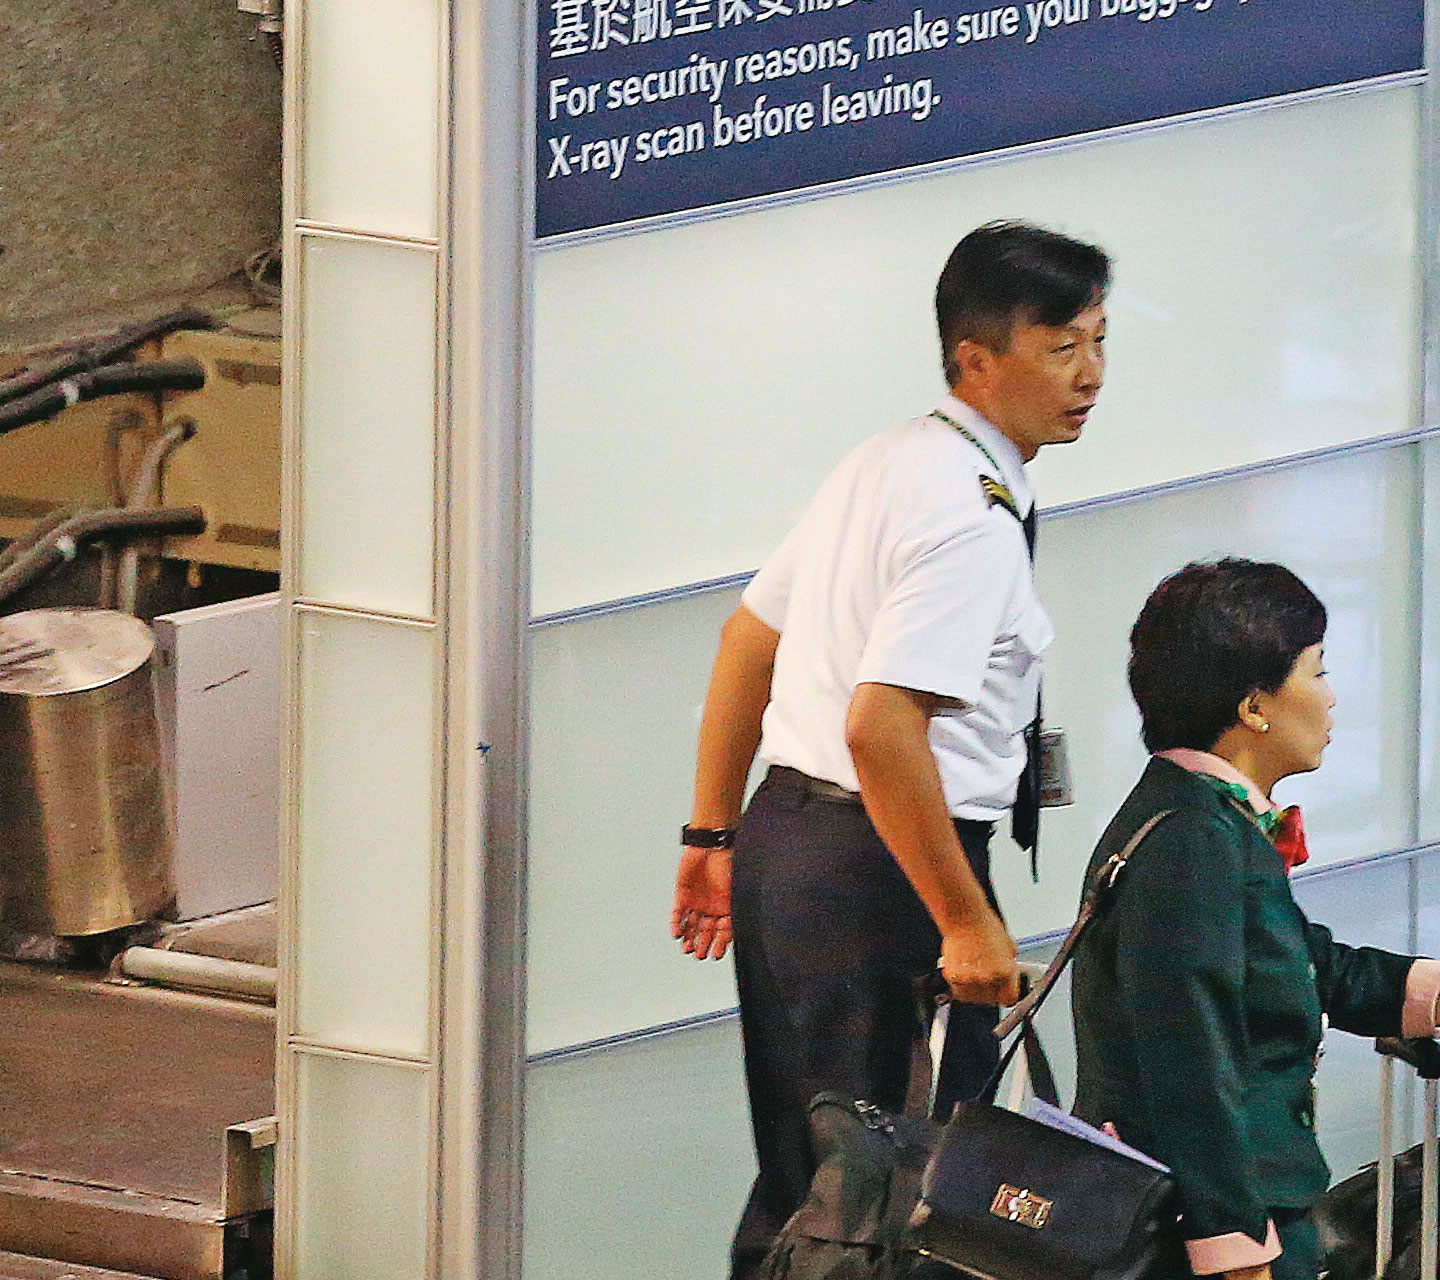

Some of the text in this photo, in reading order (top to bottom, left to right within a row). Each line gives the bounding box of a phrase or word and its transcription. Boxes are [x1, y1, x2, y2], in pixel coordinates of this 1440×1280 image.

[549, 77, 601, 120] For
[606, 53, 728, 109] security
[735, 37, 859, 85] reasons,
[867, 9, 949, 60] make
[956, 6, 1020, 44] sure
[548, 74, 941, 180] X-ray scan before leaving.
